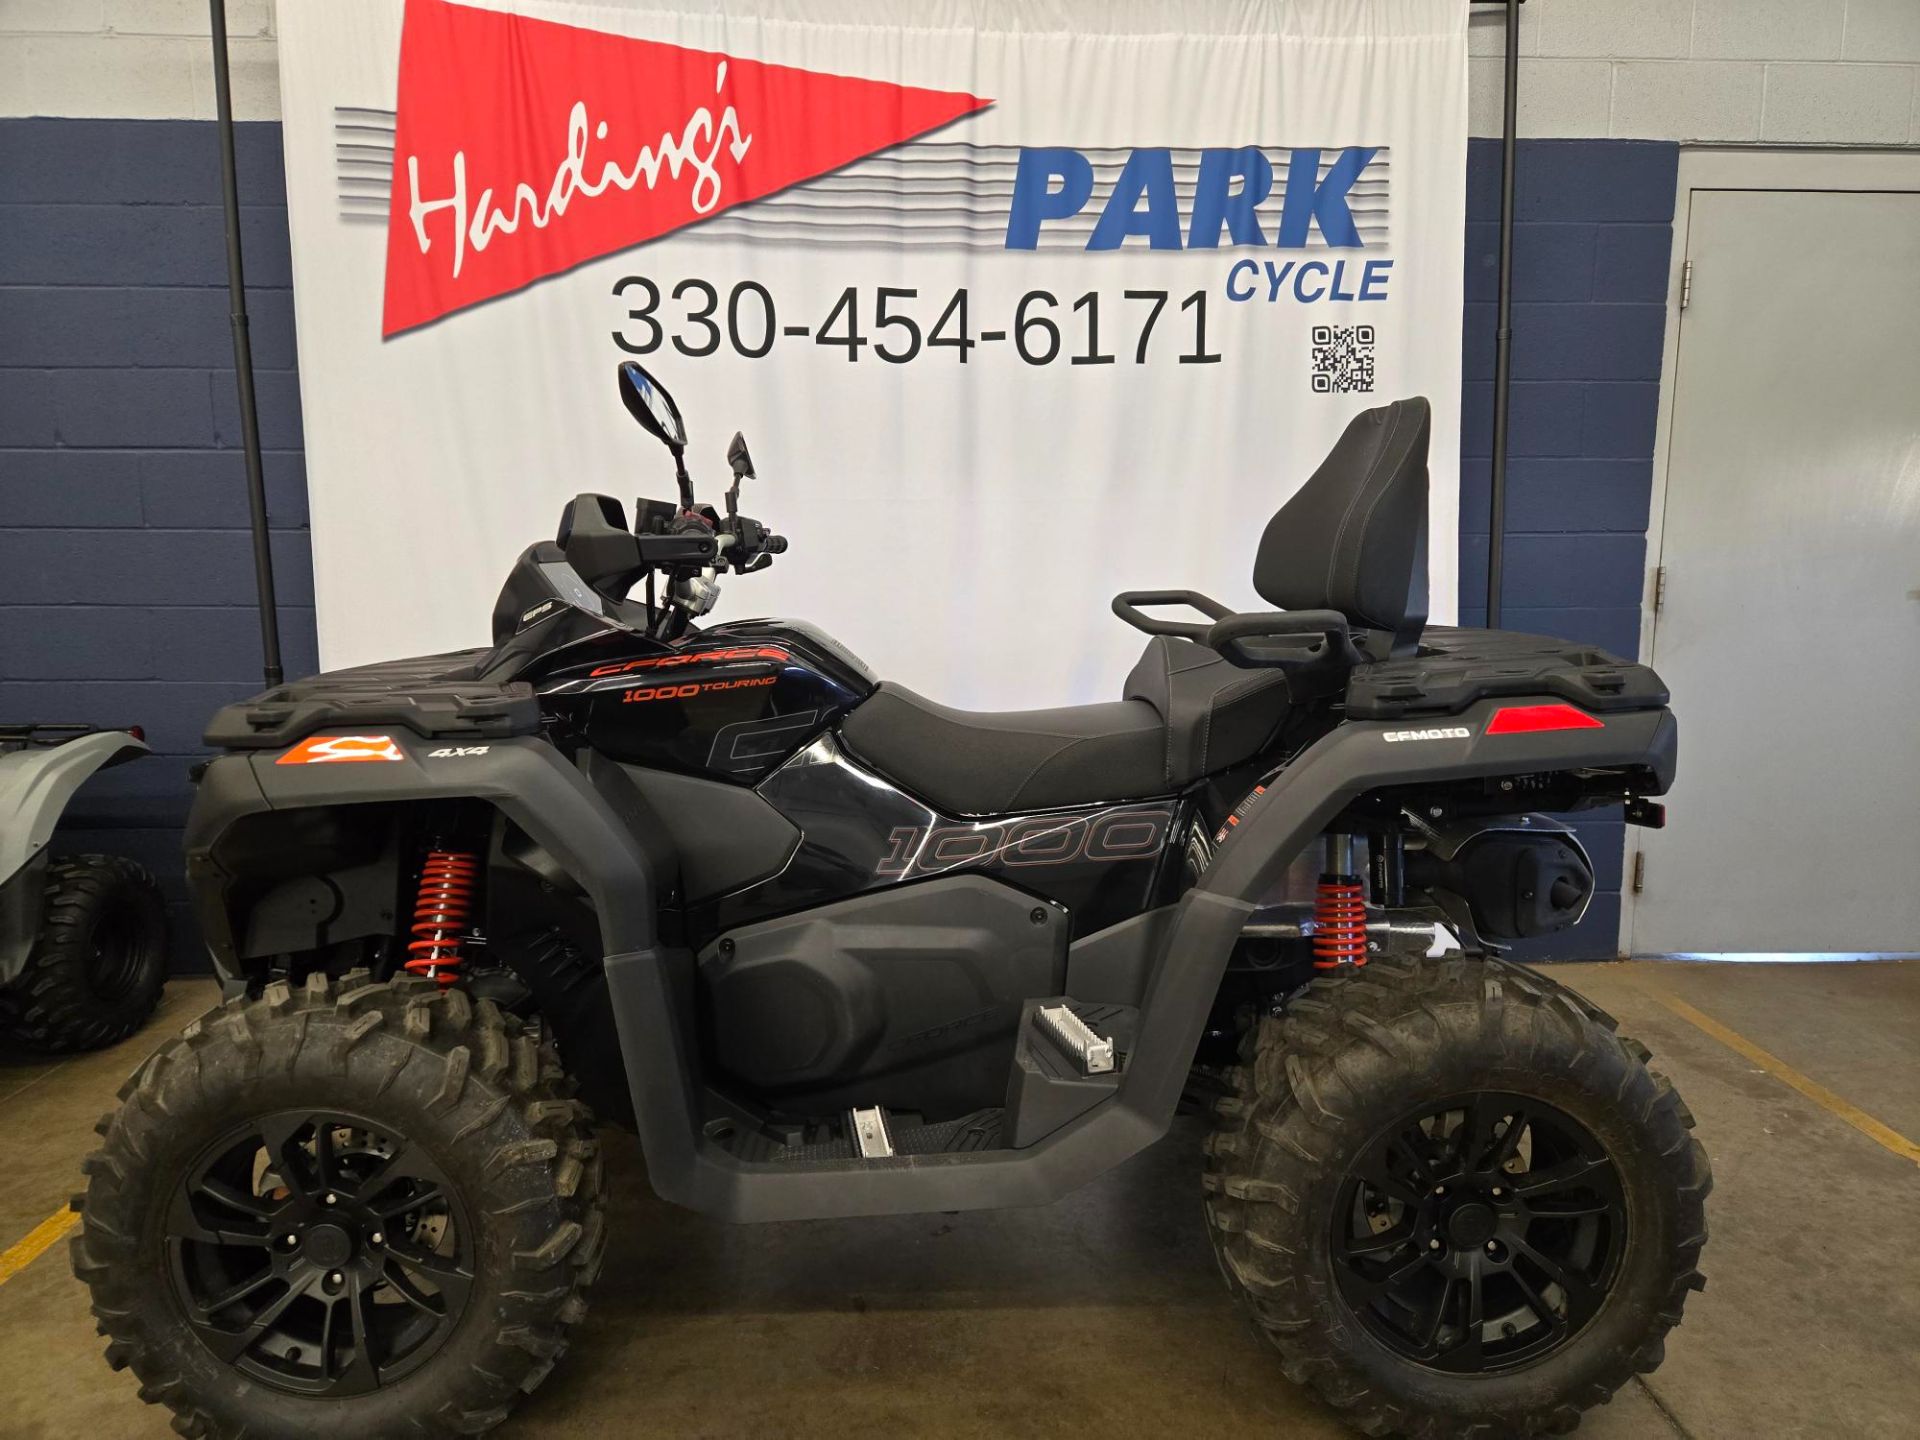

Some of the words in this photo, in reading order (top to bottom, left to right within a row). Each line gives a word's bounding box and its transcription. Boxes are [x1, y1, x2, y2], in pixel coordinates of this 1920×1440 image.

[407, 60, 752, 278] Harding's
[1004, 147, 1379, 251] PARK
[1225, 259, 1394, 303] CYCLE
[610, 275, 1222, 366] 330-454-6171
[590, 647, 790, 677] CFORCE
[623, 684, 700, 703] 1000
[702, 676, 778, 691] TOURING
[1382, 727, 1470, 742] CFMOTO
[876, 811, 1170, 874] 1000
